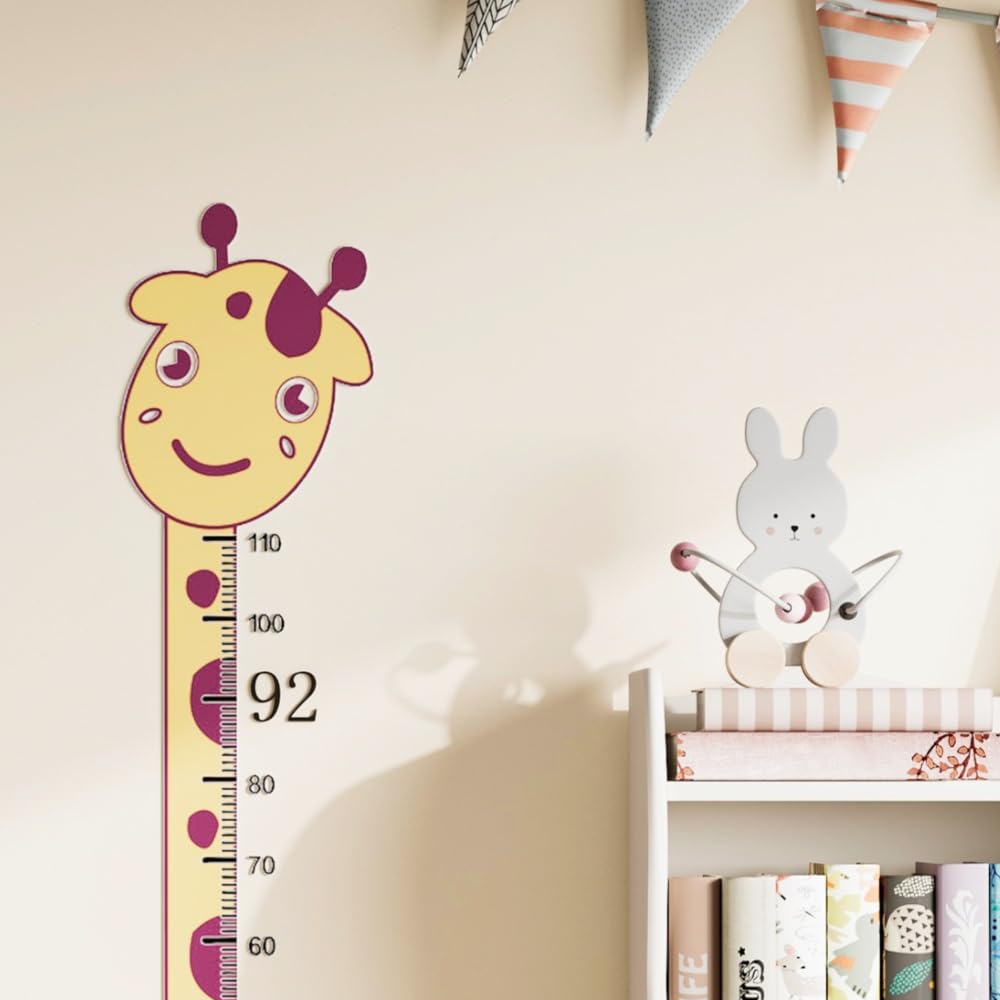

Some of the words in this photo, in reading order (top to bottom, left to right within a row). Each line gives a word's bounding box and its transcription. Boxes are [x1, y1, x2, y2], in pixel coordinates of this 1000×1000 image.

[248, 533, 282, 552] 110
[248, 613, 285, 634] 100
[249, 671, 318, 723] 92
[247, 774, 275, 795] 80
[247, 856, 275, 875] 70
[248, 936, 276, 957] 60
